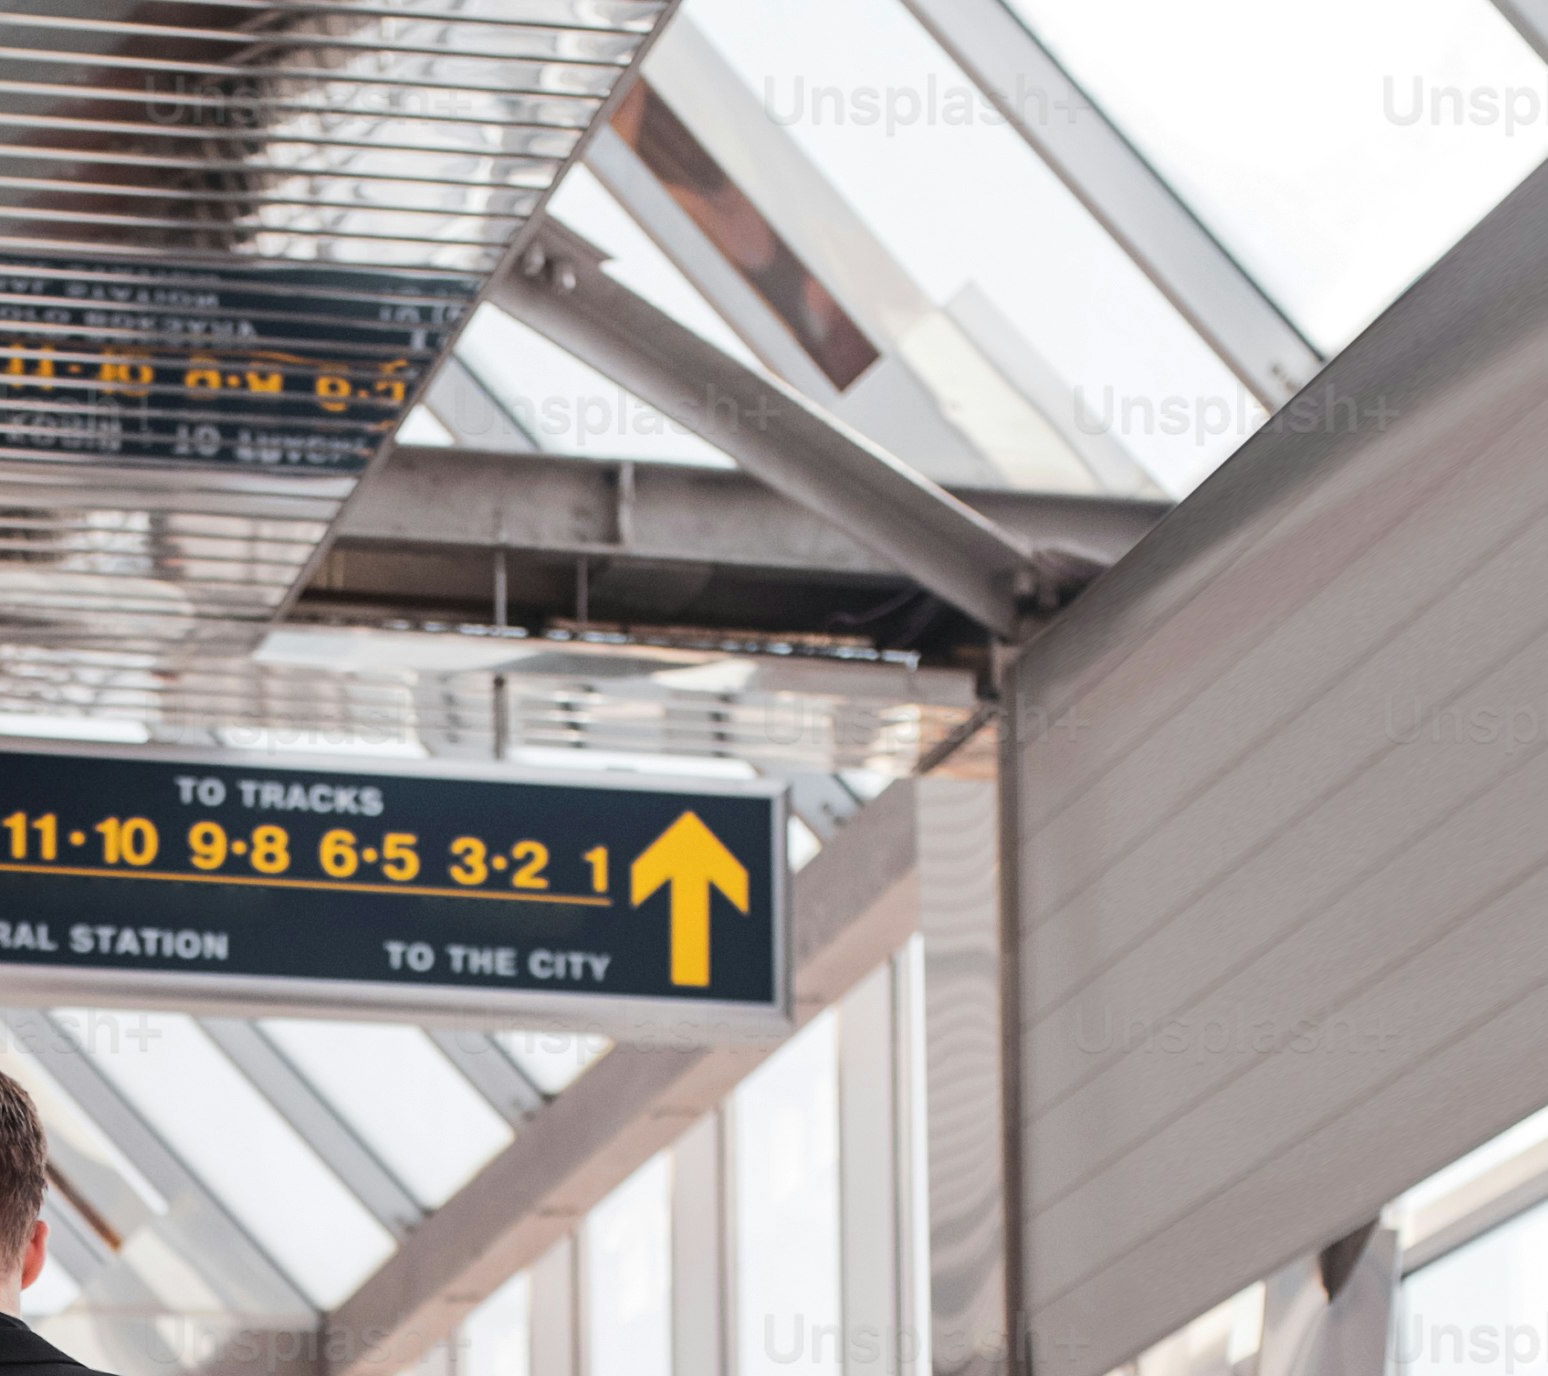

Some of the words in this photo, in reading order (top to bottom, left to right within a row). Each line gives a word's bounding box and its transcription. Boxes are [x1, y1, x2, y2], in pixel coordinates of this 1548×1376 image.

[177, 776, 226, 806] TO
[239, 780, 384, 817] TRACKS
[584, 846, 608, 893] 1
[70, 924, 229, 960] STATION
[384, 941, 435, 972] TO
[447, 945, 517, 976] THE
[528, 949, 610, 981] CITY
